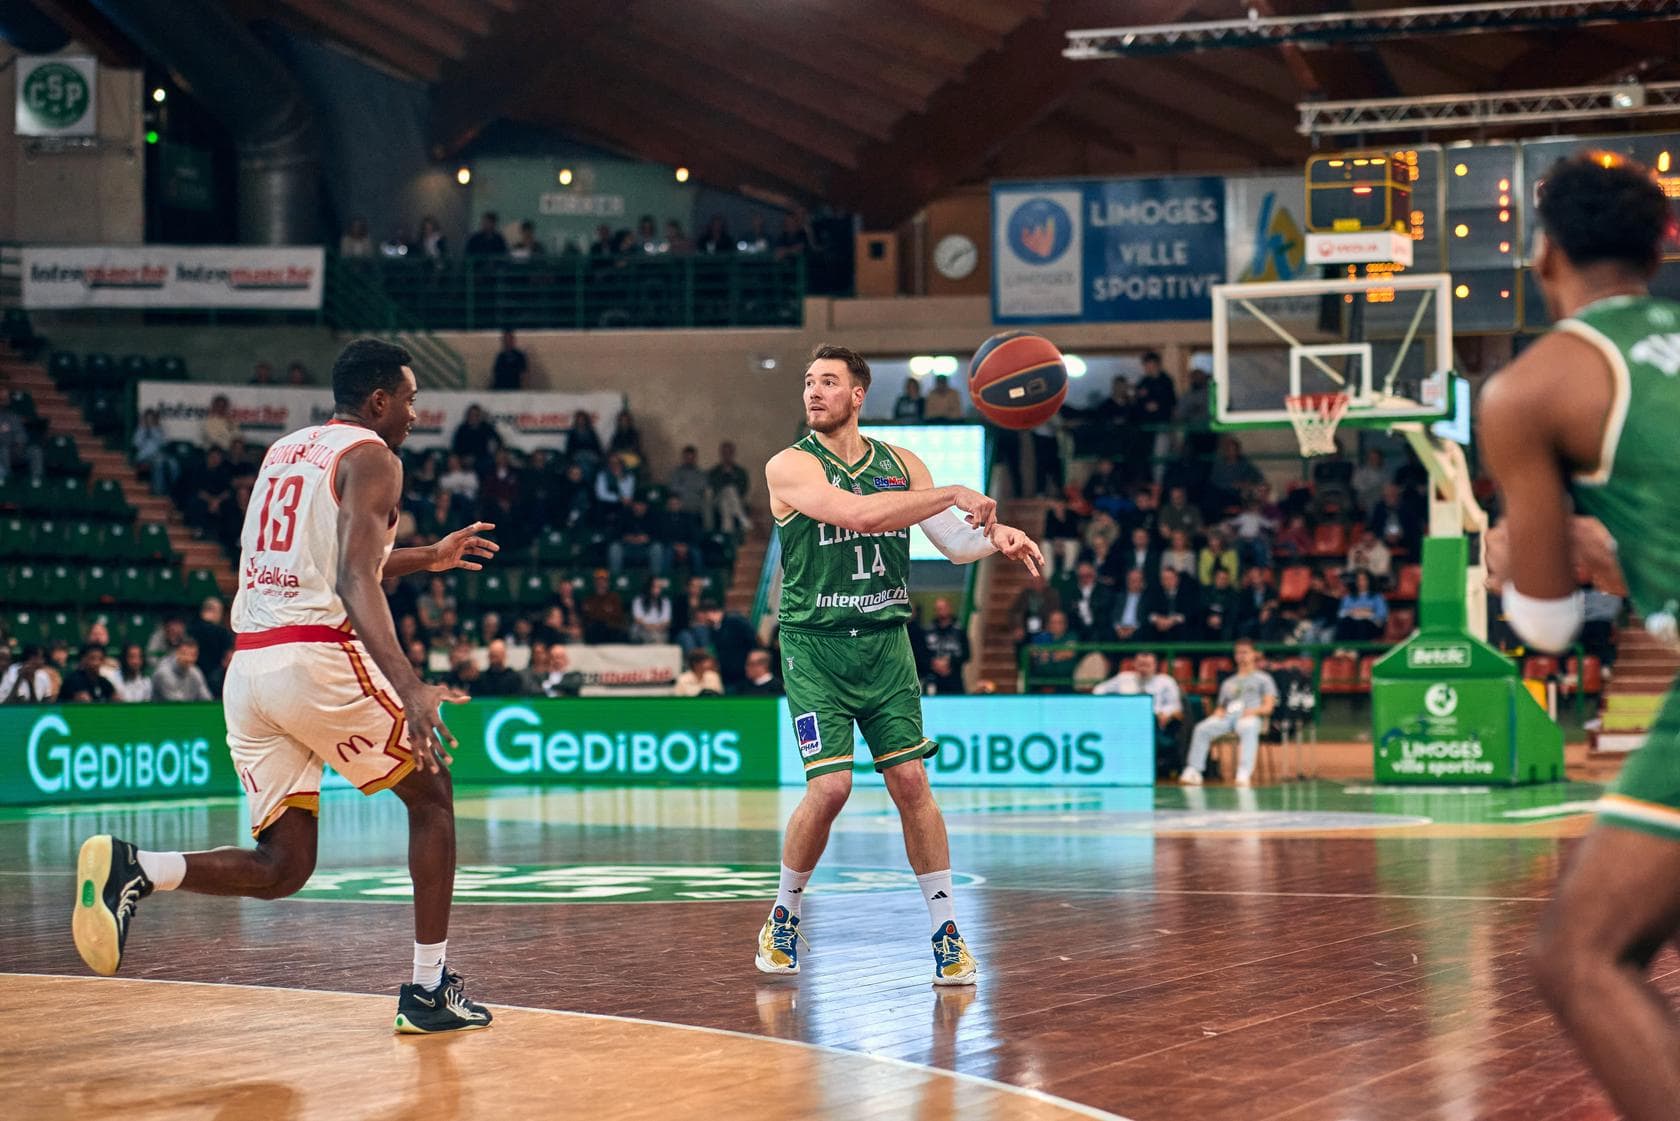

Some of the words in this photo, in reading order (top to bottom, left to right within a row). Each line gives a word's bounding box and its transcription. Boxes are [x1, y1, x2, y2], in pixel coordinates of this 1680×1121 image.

[1091, 198, 1217, 226] LIMOGES
[1120, 242, 1189, 266] VILLE
[256, 475, 304, 552] 13
[852, 543, 886, 580] 14
[258, 565, 299, 588] dalkia
[1401, 740, 1483, 760] LIMOGES
[1391, 759, 1425, 774] ville
[1427, 759, 1494, 778] sportive
